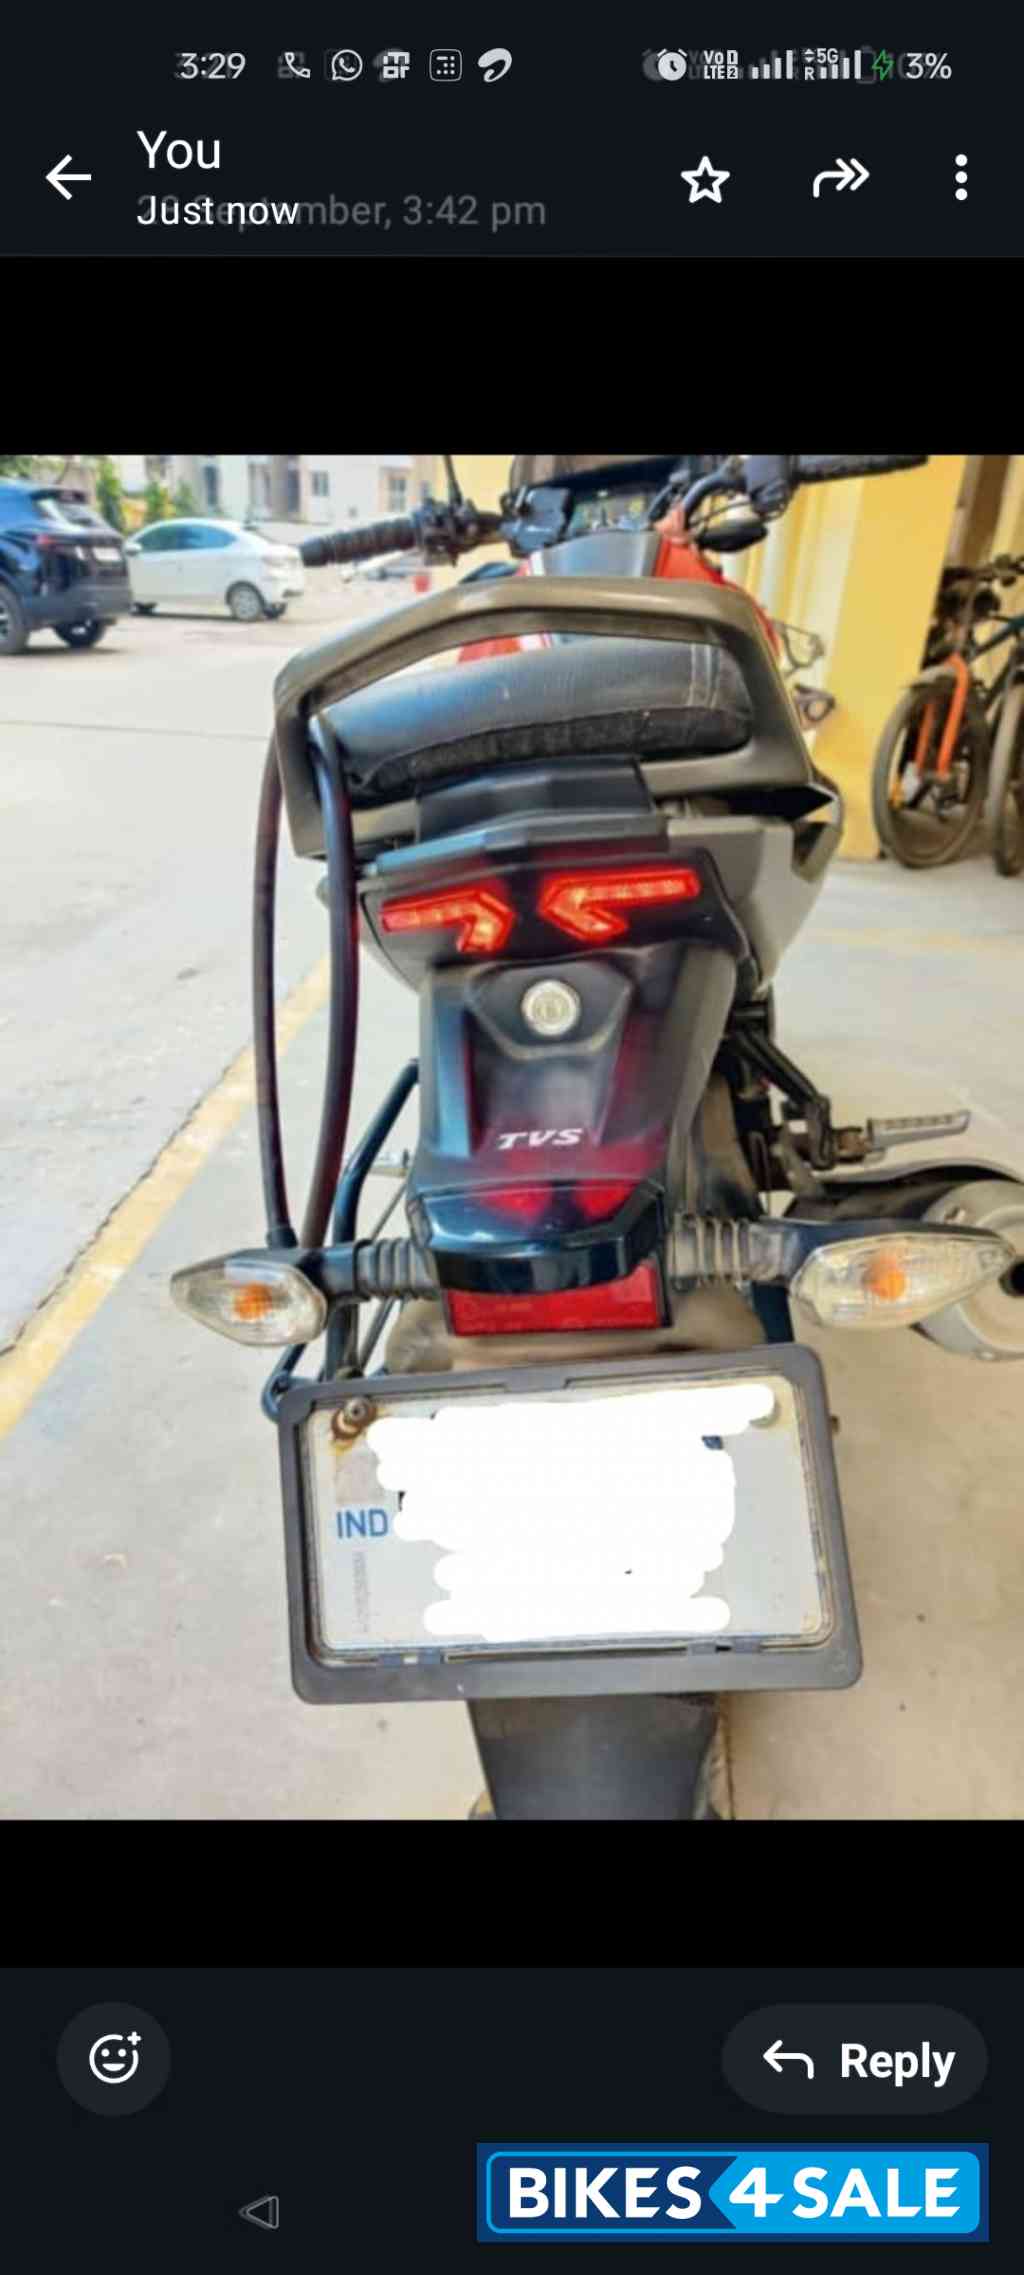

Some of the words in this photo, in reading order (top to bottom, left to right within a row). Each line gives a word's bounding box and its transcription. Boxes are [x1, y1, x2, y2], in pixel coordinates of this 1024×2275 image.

[181, 52, 246, 79] 3:29
[816, 48, 839, 64] 5G
[906, 53, 952, 79] 3%
[136, 130, 221, 169] You
[137, 195, 214, 225] Just
[227, 202, 299, 225] now
[403, 194, 479, 225] 3:42
[491, 201, 546, 233] pm
[500, 1128, 583, 1149] TVS
[336, 1509, 388, 1539] IND
[841, 2041, 956, 2088] Reply
